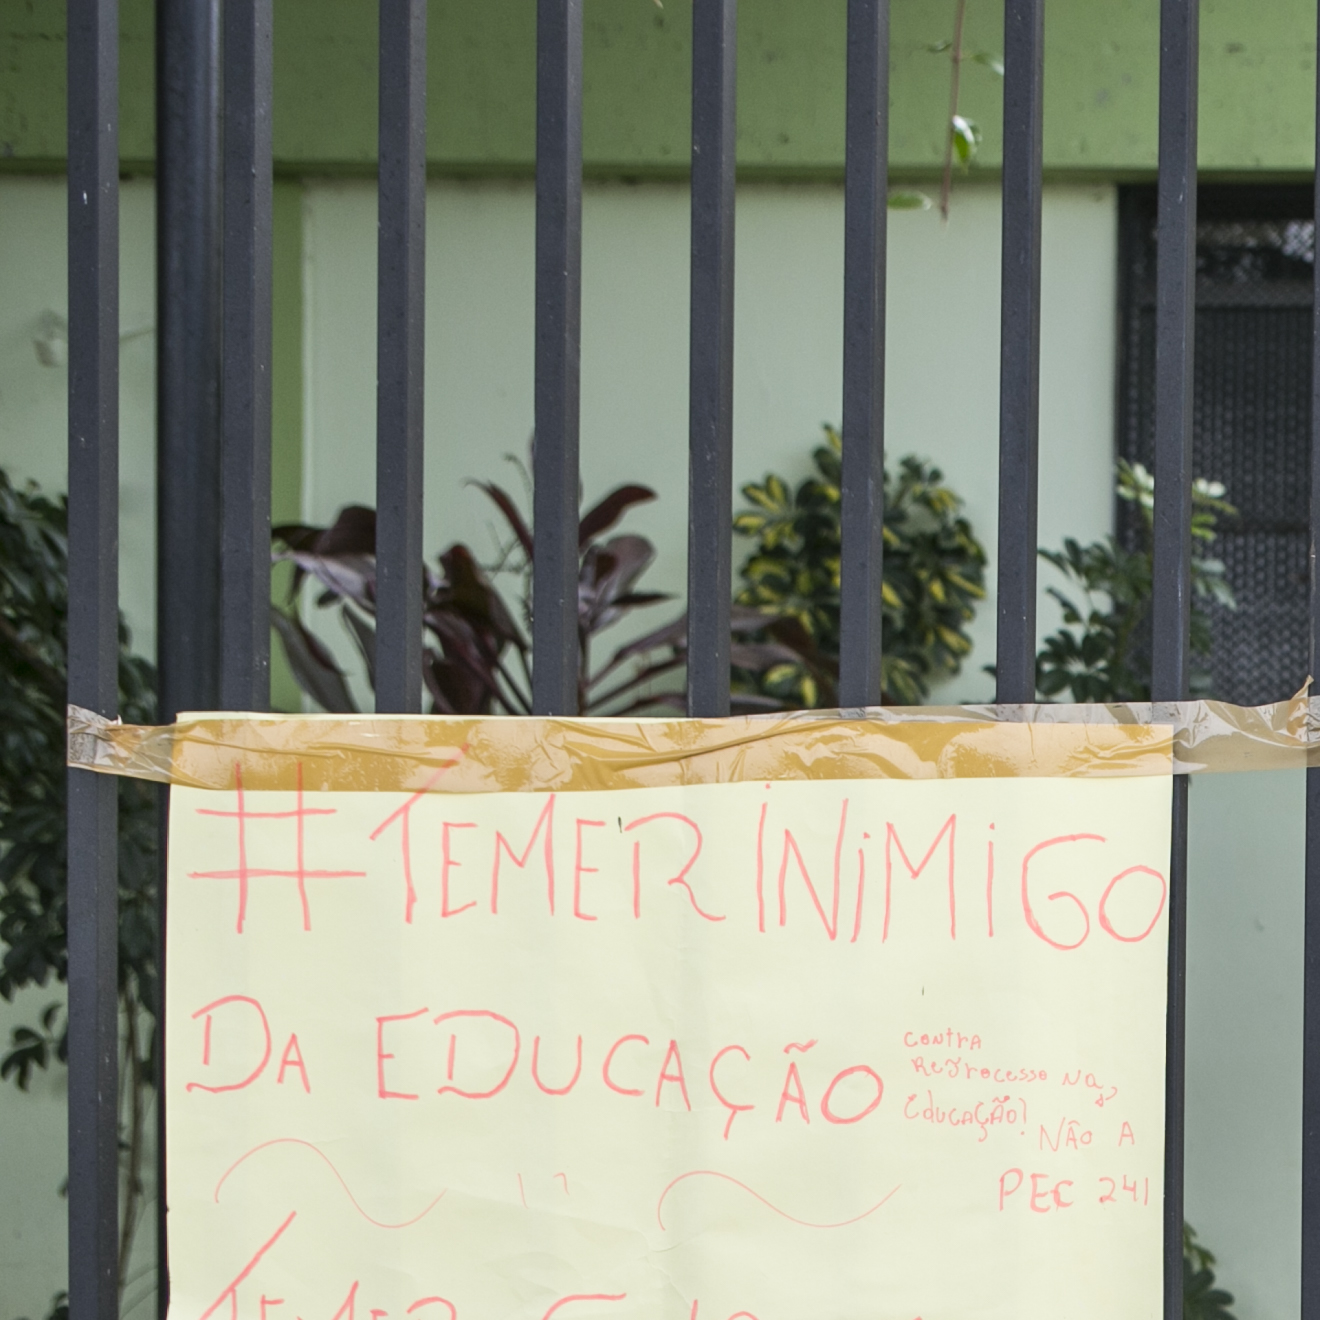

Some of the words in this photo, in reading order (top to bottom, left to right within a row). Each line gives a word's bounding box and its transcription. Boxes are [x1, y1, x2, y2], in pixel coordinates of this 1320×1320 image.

[185, 994, 312, 1094] DA
[374, 1007, 885, 1141] EDUCAÇÃO
[1118, 1121, 1135, 1147] A
[999, 1167, 1074, 1213] PEC
[1098, 1175, 1149, 1206] 241
